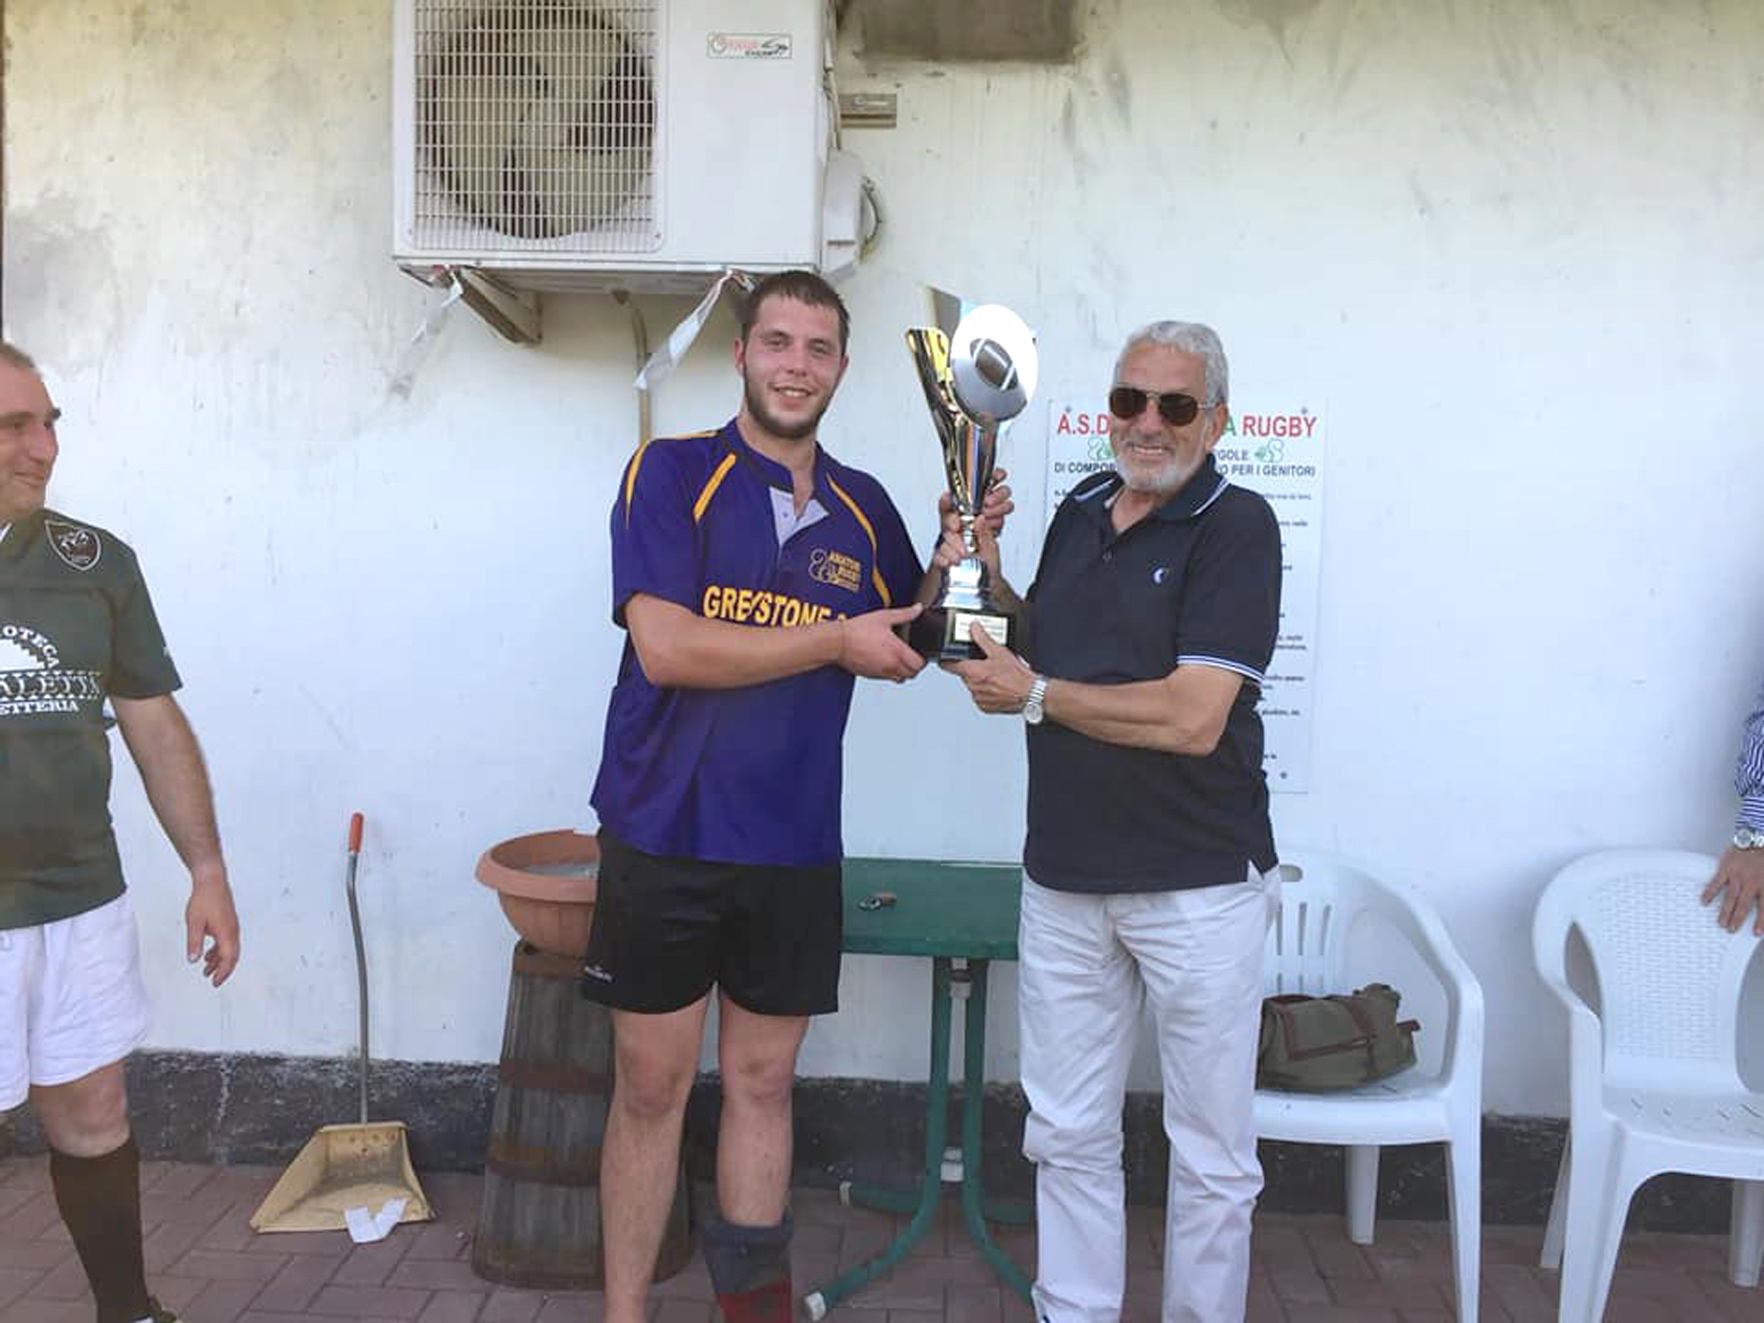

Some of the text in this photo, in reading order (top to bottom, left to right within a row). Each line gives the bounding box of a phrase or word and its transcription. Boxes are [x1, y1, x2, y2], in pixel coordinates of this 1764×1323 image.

[1242, 415, 1317, 437] RUGBY
[1217, 449, 1248, 461] GOLE
[1054, 462, 1066, 473] DI
[1231, 464, 1254, 476] PER
[1262, 464, 1316, 477] GENITORI
[0, 625, 60, 669] OTECA
[0, 700, 80, 715] ETTERIA
